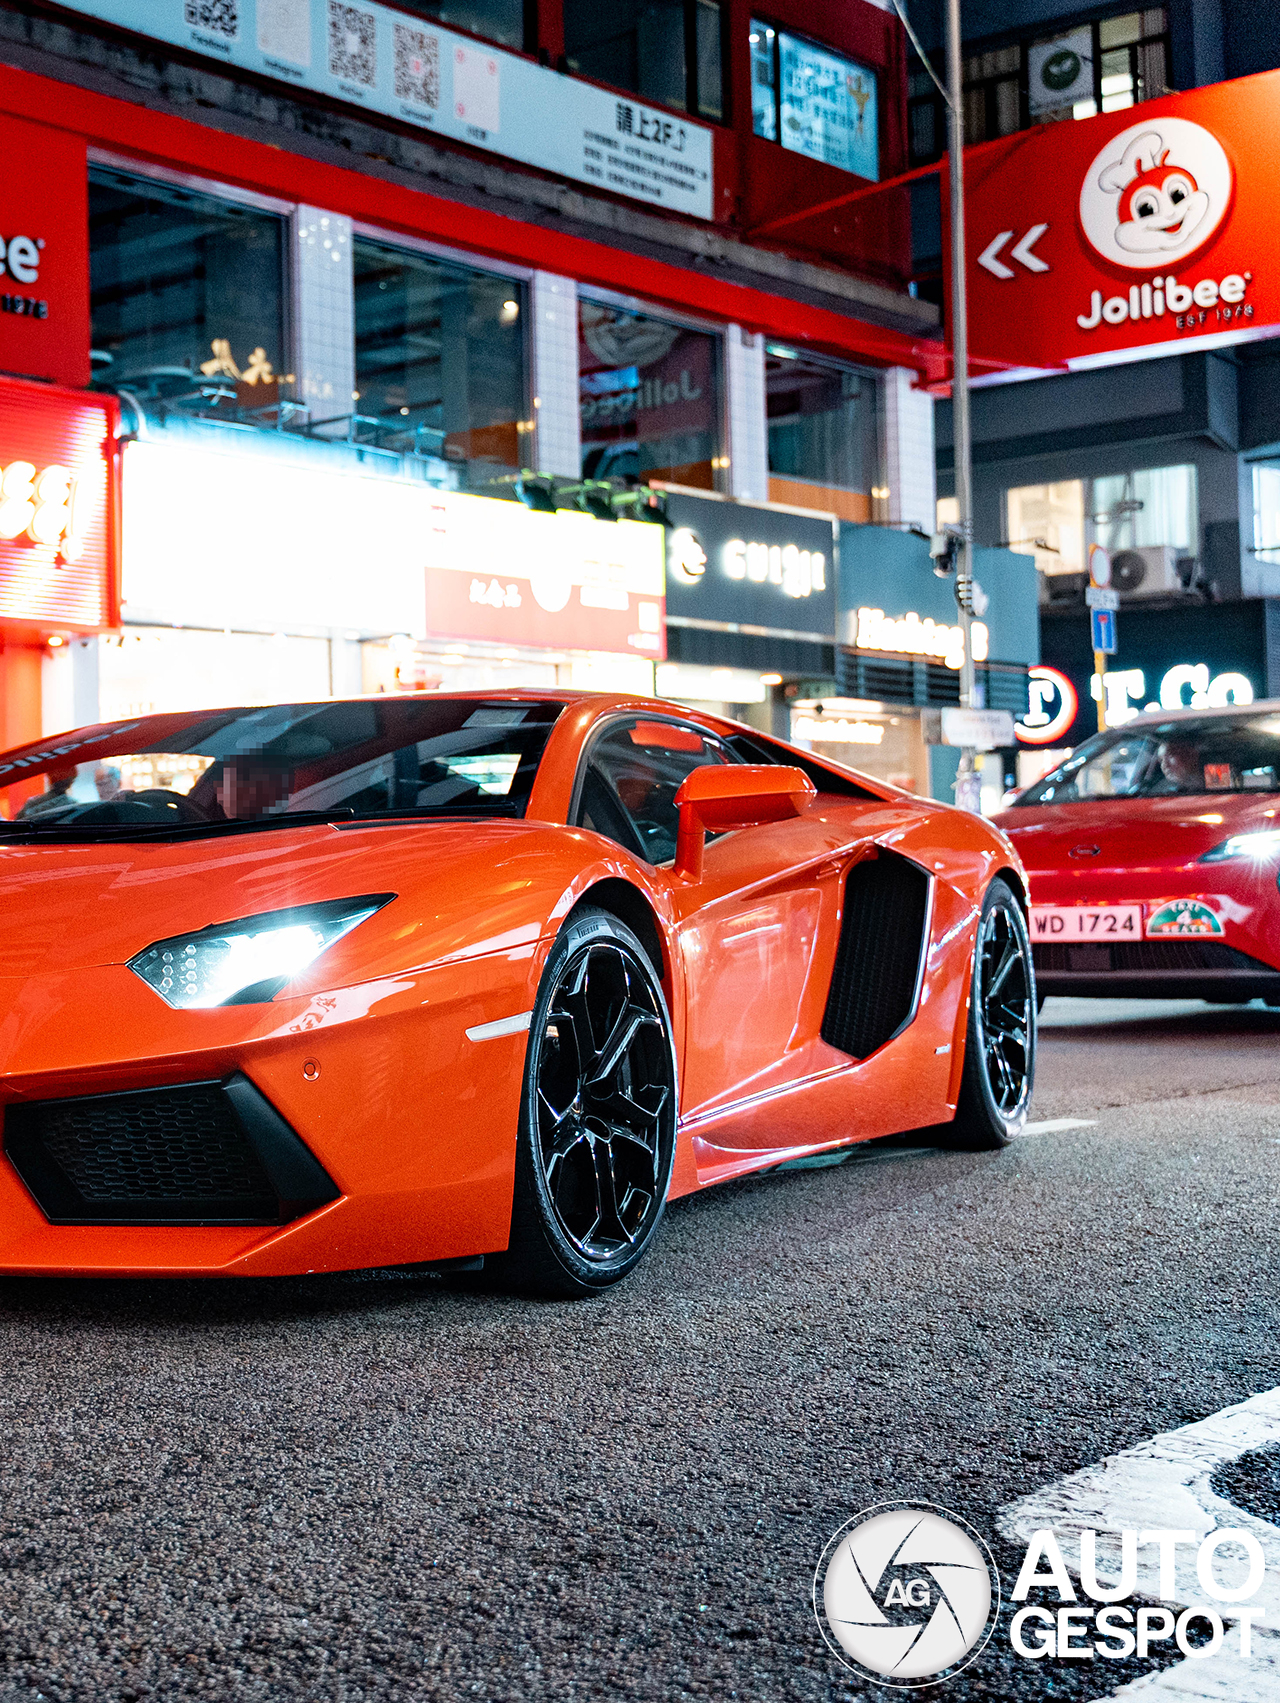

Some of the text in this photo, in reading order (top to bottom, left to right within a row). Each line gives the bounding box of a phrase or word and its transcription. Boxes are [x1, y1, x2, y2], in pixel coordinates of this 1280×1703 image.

[2, 293, 49, 319] 1978
[1076, 274, 1247, 329] Jollibee
[1176, 303, 1254, 329] EST 1978
[1035, 914, 1134, 934] WD 1724
[1176, 910, 1192, 924] 4
